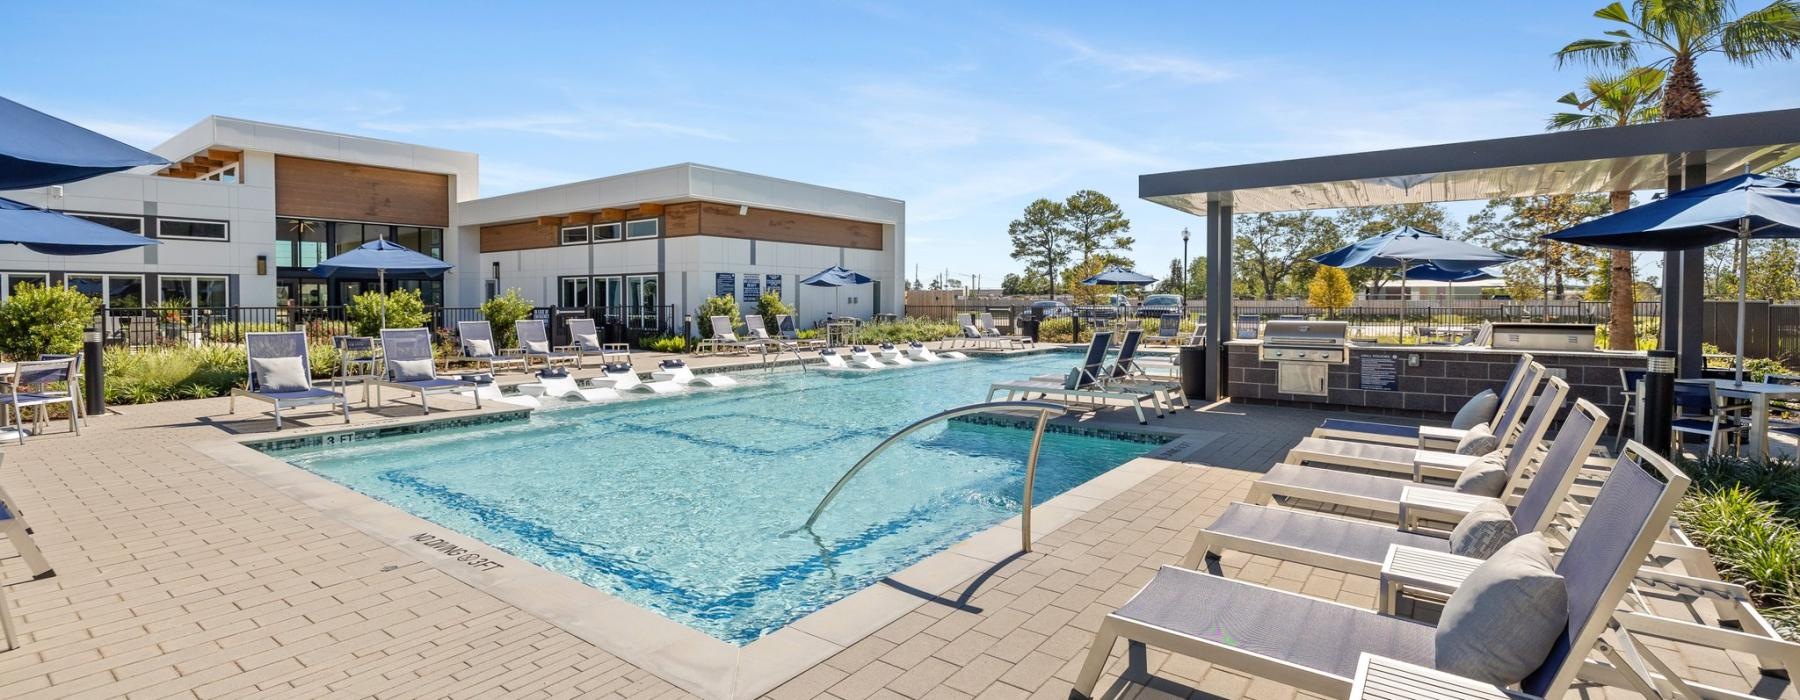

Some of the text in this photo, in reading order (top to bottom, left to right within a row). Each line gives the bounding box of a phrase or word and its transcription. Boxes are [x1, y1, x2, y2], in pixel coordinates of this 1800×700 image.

[327, 433, 354, 445] 3 FT
[409, 532, 436, 541] NO
[423, 538, 468, 556] DIVING
[472, 560, 505, 572] FT
